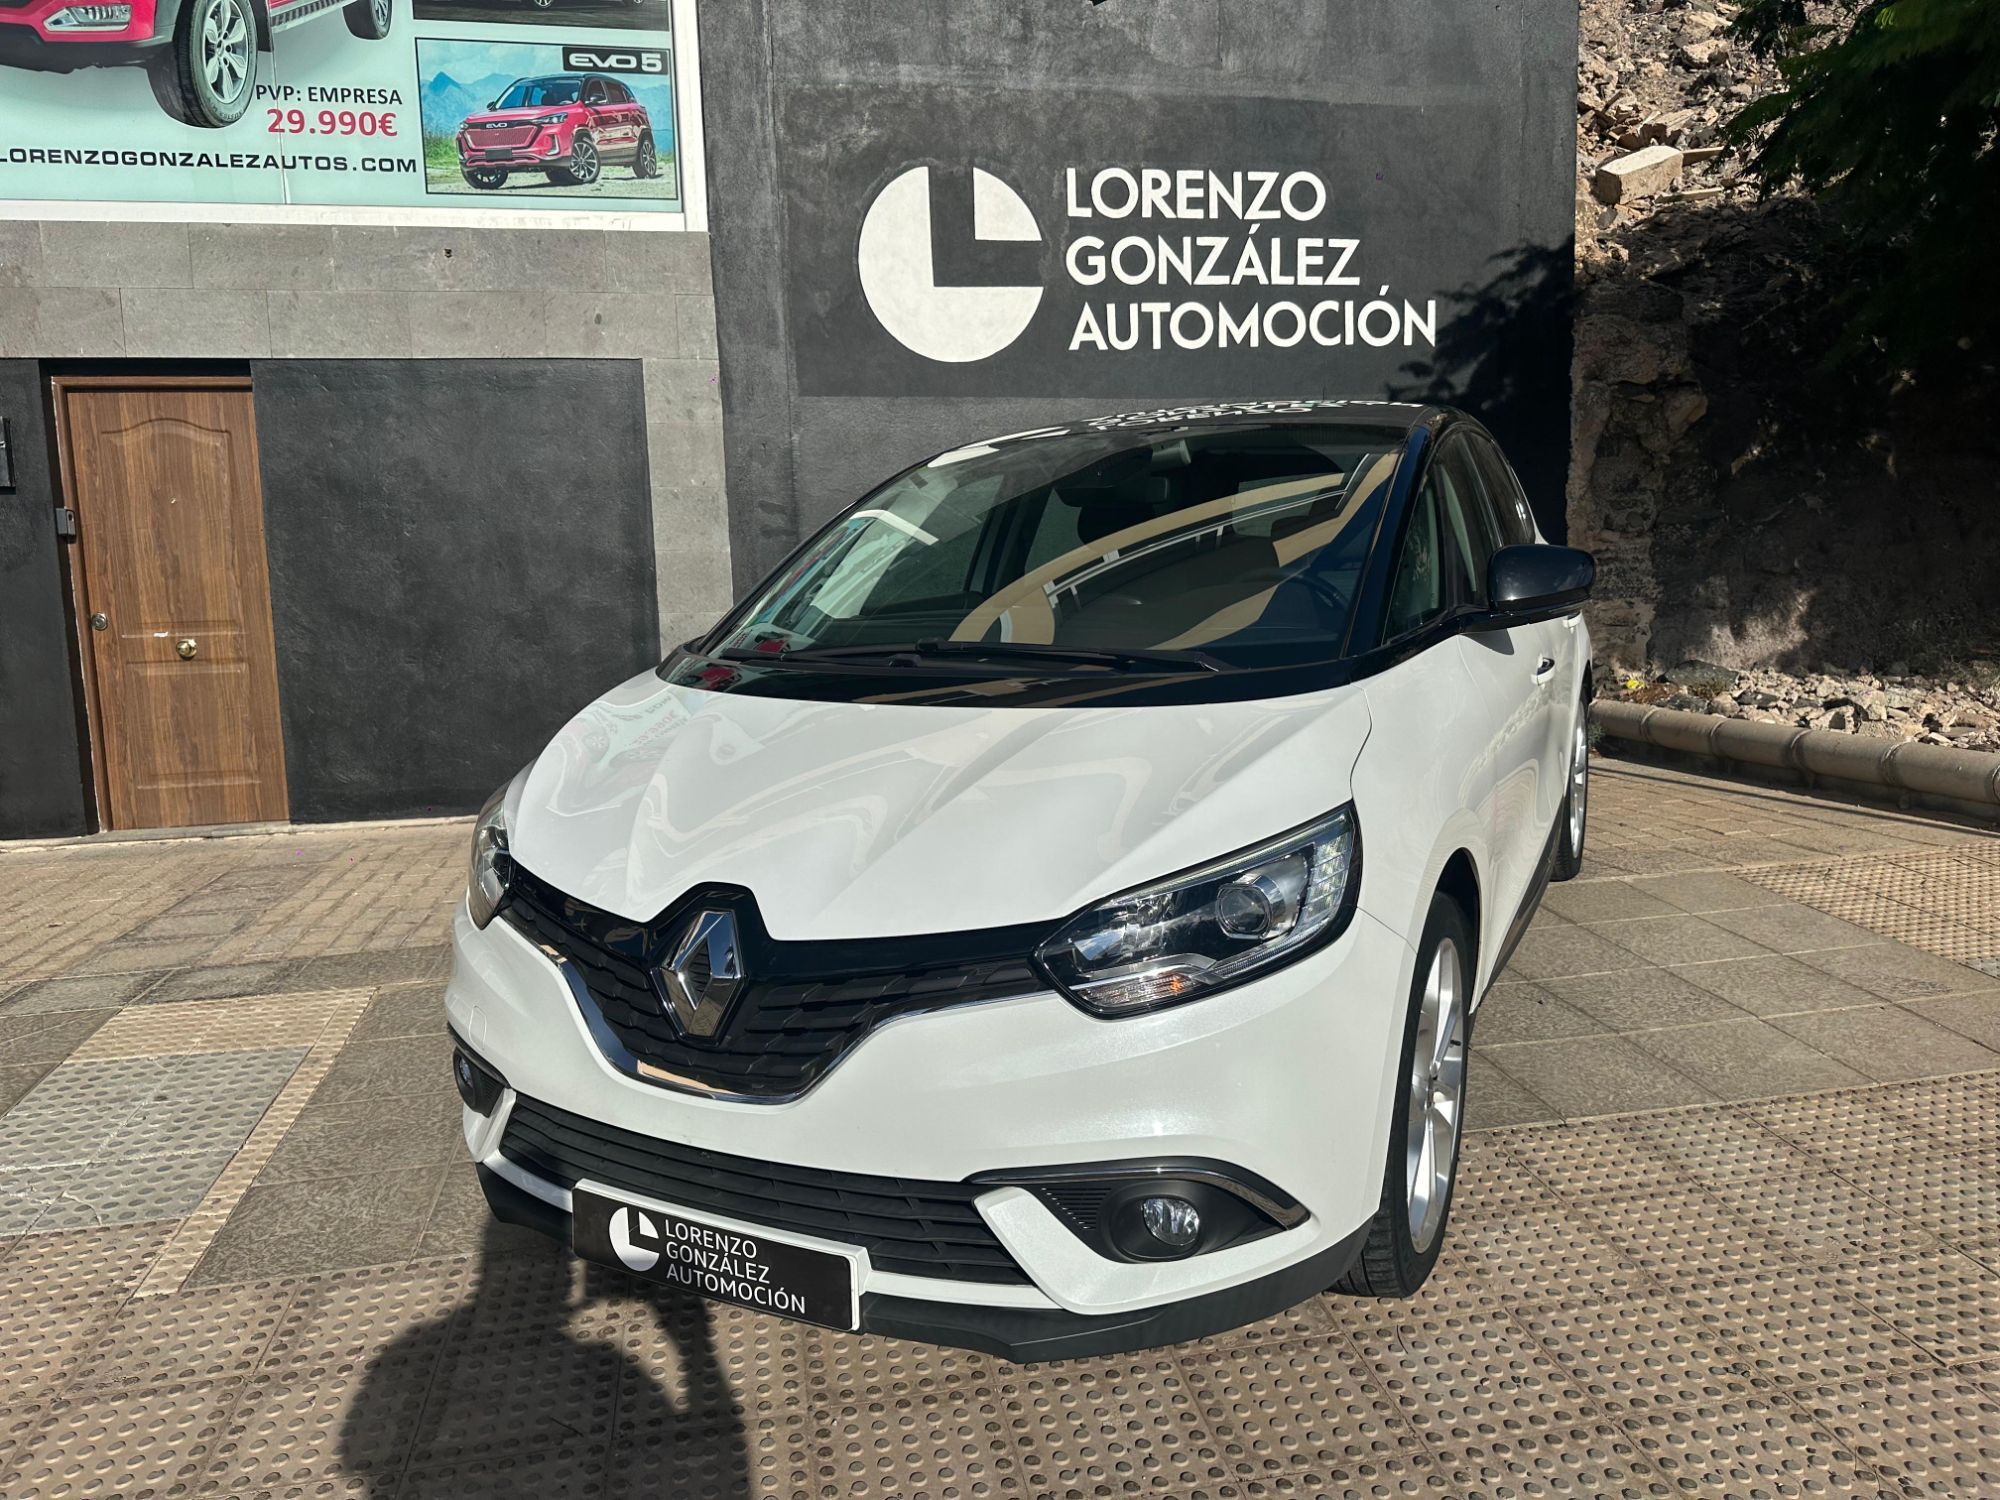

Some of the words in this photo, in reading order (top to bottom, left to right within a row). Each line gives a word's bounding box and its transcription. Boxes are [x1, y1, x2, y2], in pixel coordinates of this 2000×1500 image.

[568, 53, 638, 69] EVO
[641, 52, 663, 73] 5
[255, 84, 302, 102] PVP:
[307, 86, 403, 105] EMPRESA
[266, 108, 398, 137] 29.990€
[1065, 167, 1327, 222] LORENZO
[1065, 223, 1361, 287] GONZÁLEZ
[1067, 285, 1437, 351] AUTOMOCIÓN
[665, 1219, 757, 1259] LORENZO
[666, 1241, 771, 1285] GONZÁLEZ
[666, 1263, 806, 1315] AUTOMOCIÓN
